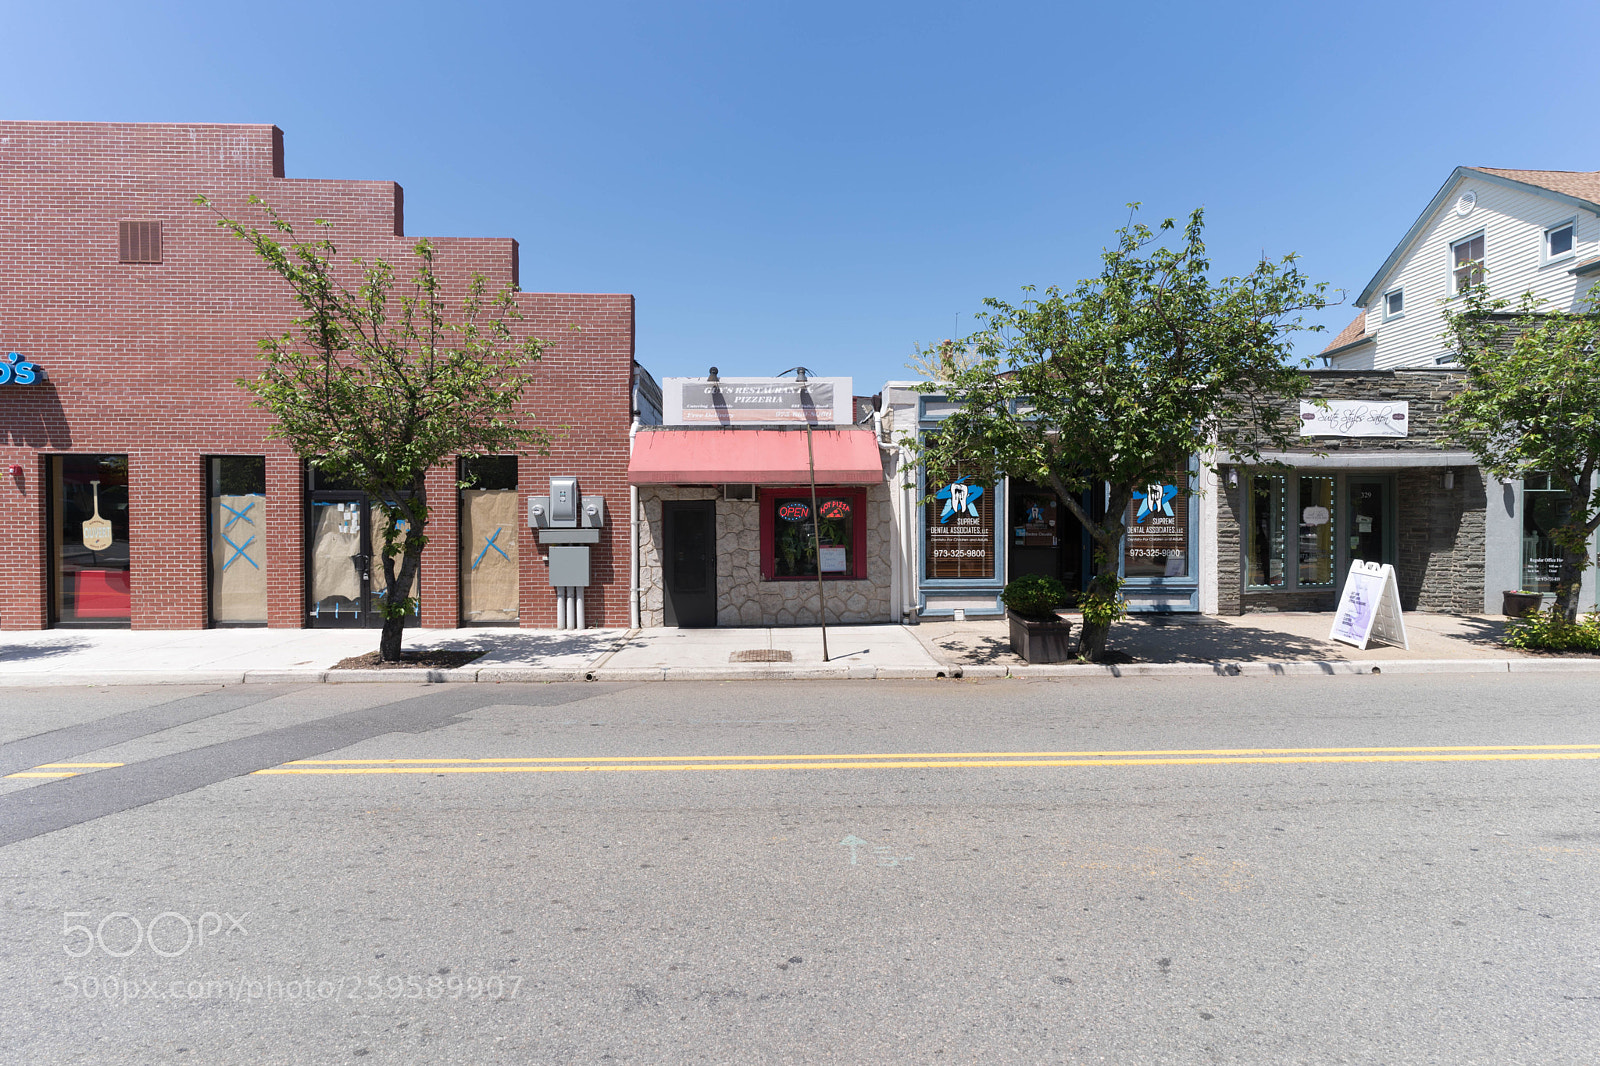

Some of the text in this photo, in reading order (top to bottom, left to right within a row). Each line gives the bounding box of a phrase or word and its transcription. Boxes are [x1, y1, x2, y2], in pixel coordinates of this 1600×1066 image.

[1318, 405, 1393, 433] Suite Styles Salon
[780, 506, 809, 517] OPEN
[820, 501, 850, 514] HOT PIZZA
[957, 517, 980, 526] SUPREME
[1152, 517, 1175, 525] SUPREME
[84, 526, 111, 539] OUVERT
[930, 526, 949, 534] DENTAL
[1127, 526, 1144, 534] DENTAL
[933, 549, 986, 558] 973-325-9800
[1129, 548, 1180, 557] 973-325-9800
